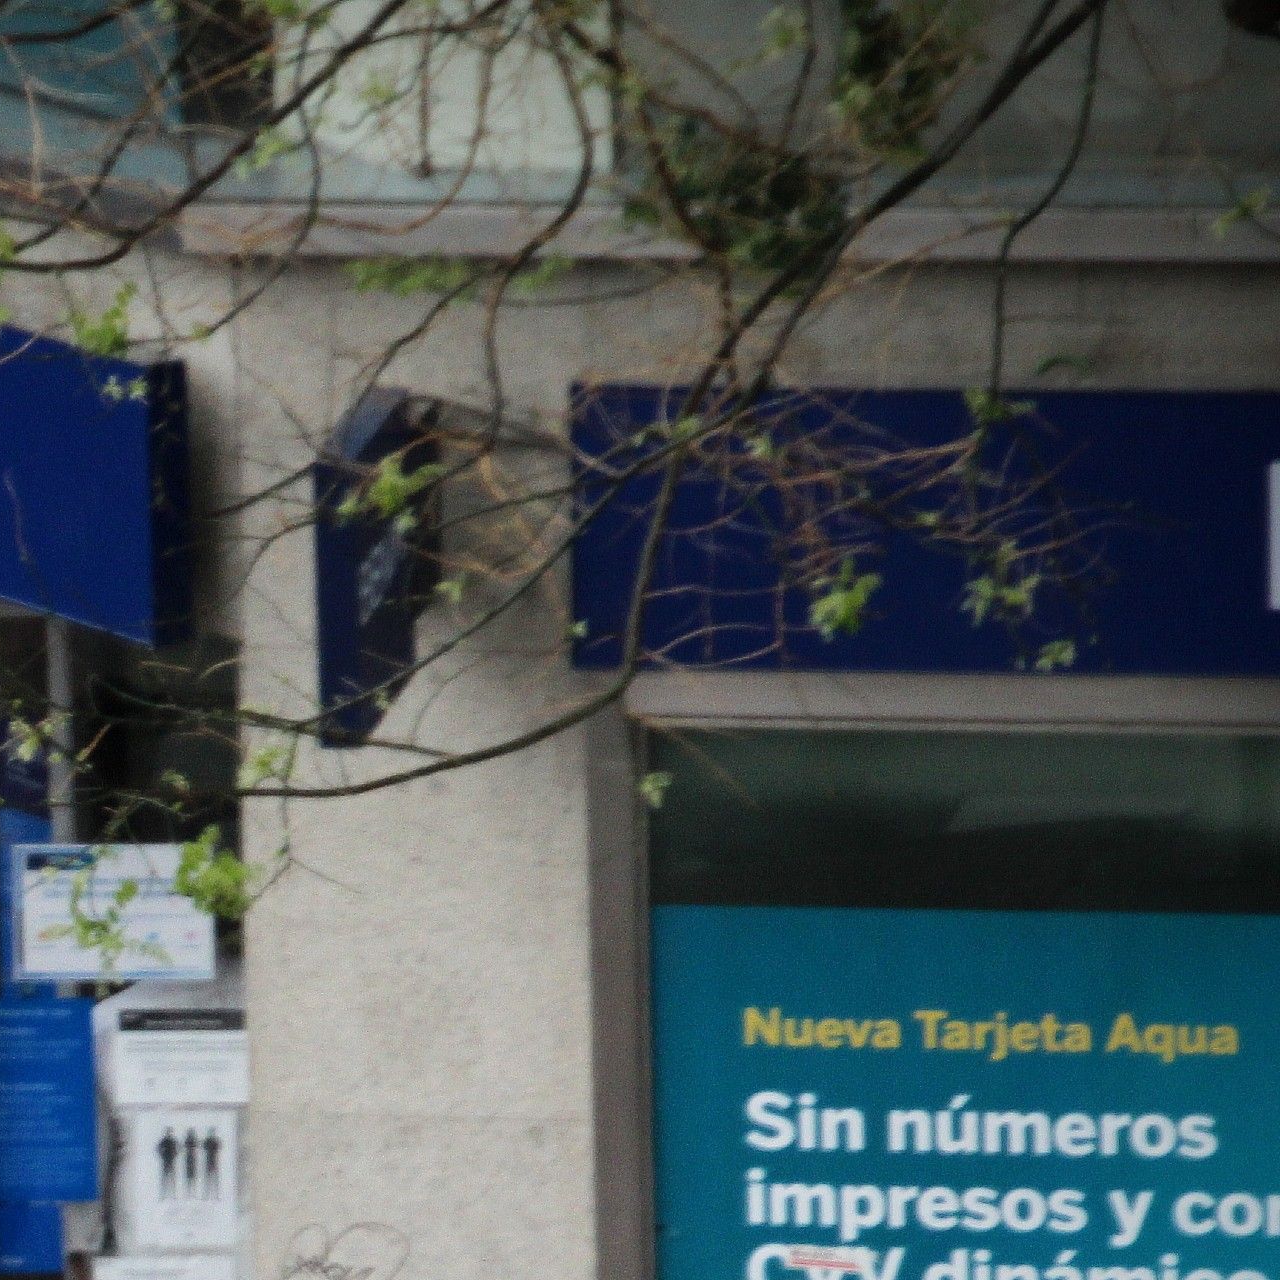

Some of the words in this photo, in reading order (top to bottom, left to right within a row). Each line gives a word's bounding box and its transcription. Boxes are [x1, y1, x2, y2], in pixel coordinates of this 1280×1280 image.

[743, 1007, 901, 1049] Nueva
[914, 1009, 1092, 1062] Tarjeta
[1105, 1012, 1240, 1064] Aqua
[745, 1090, 865, 1153] Sin
[887, 1093, 1220, 1158] números
[746, 1167, 1090, 1241] impresos
[1107, 1190, 1154, 1248] y
